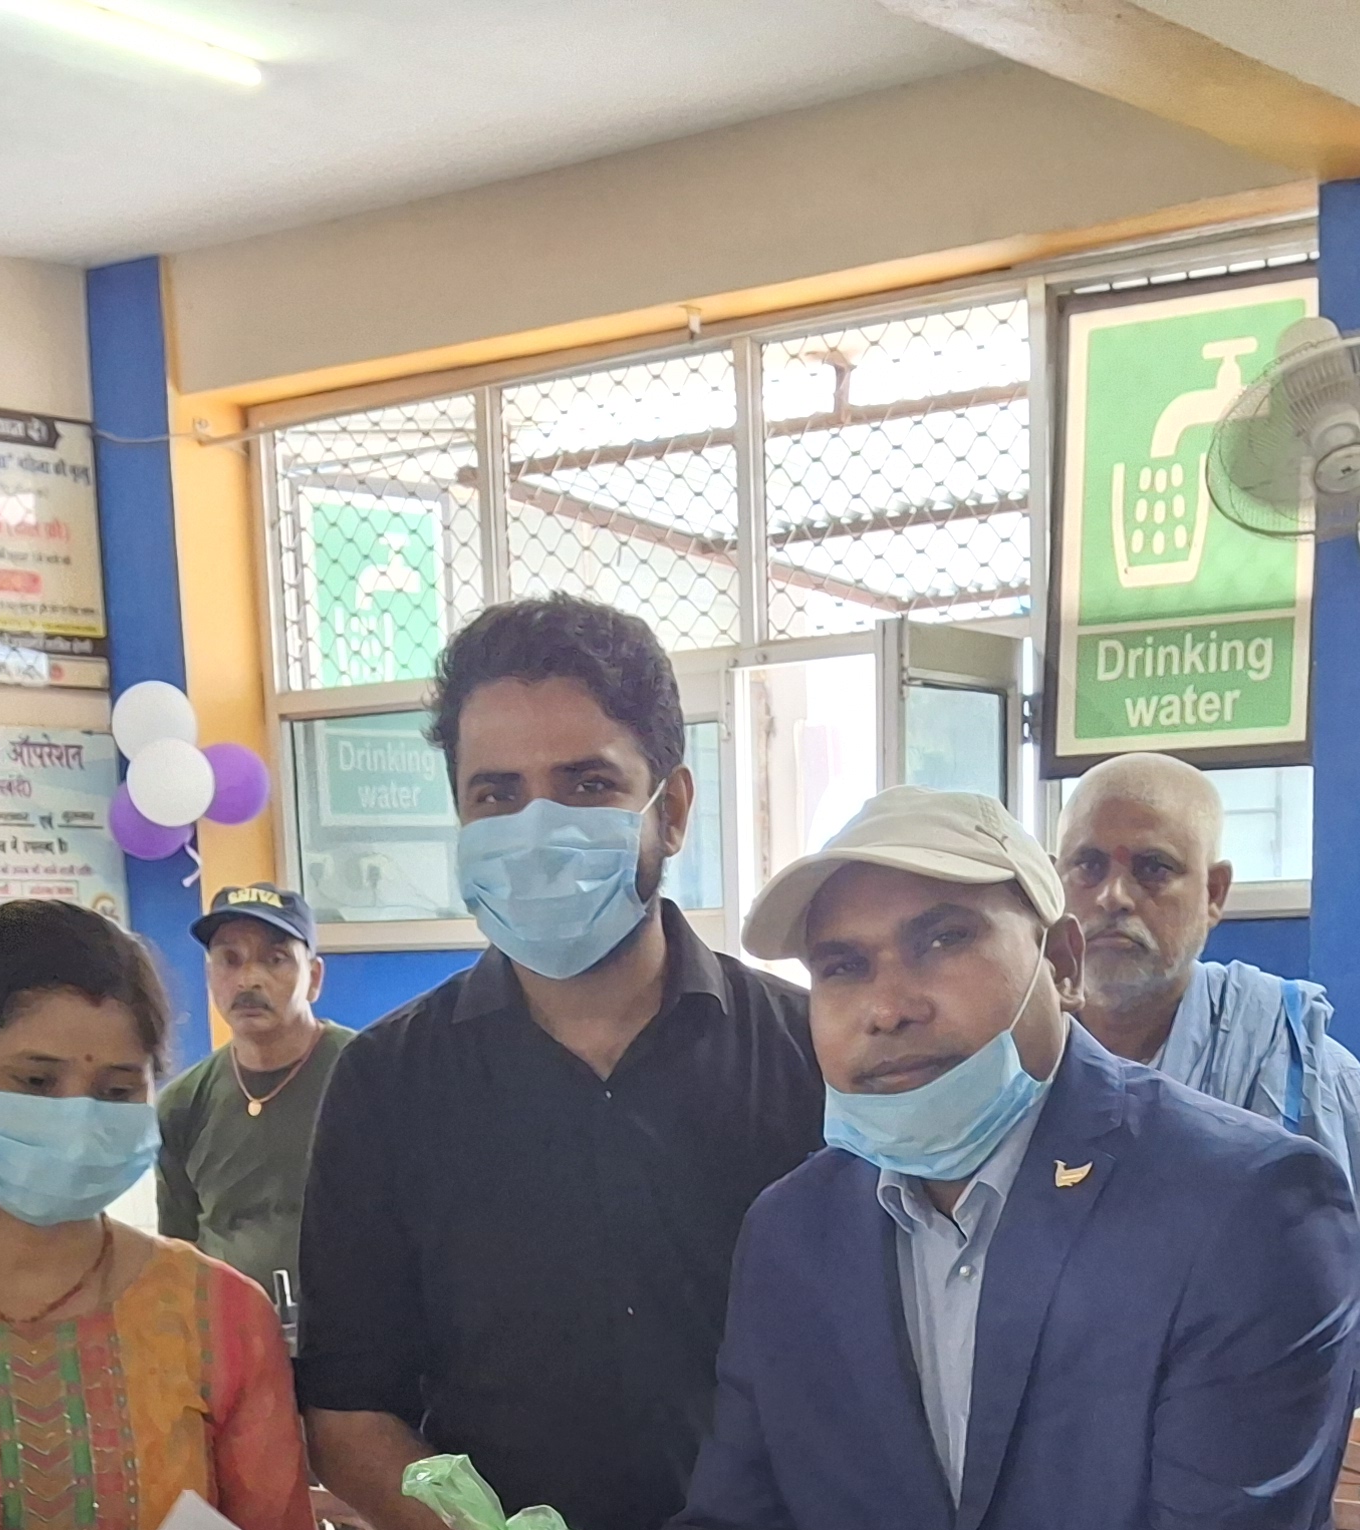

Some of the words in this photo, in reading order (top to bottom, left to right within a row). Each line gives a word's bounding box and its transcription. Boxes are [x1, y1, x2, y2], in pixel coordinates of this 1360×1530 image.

[1096, 632, 1274, 682] Drinking
[1125, 685, 1241, 728] water
[7, 734, 86, 770] ऑपरेशन
[338, 740, 436, 781] Drinking
[357, 780, 421, 808] water
